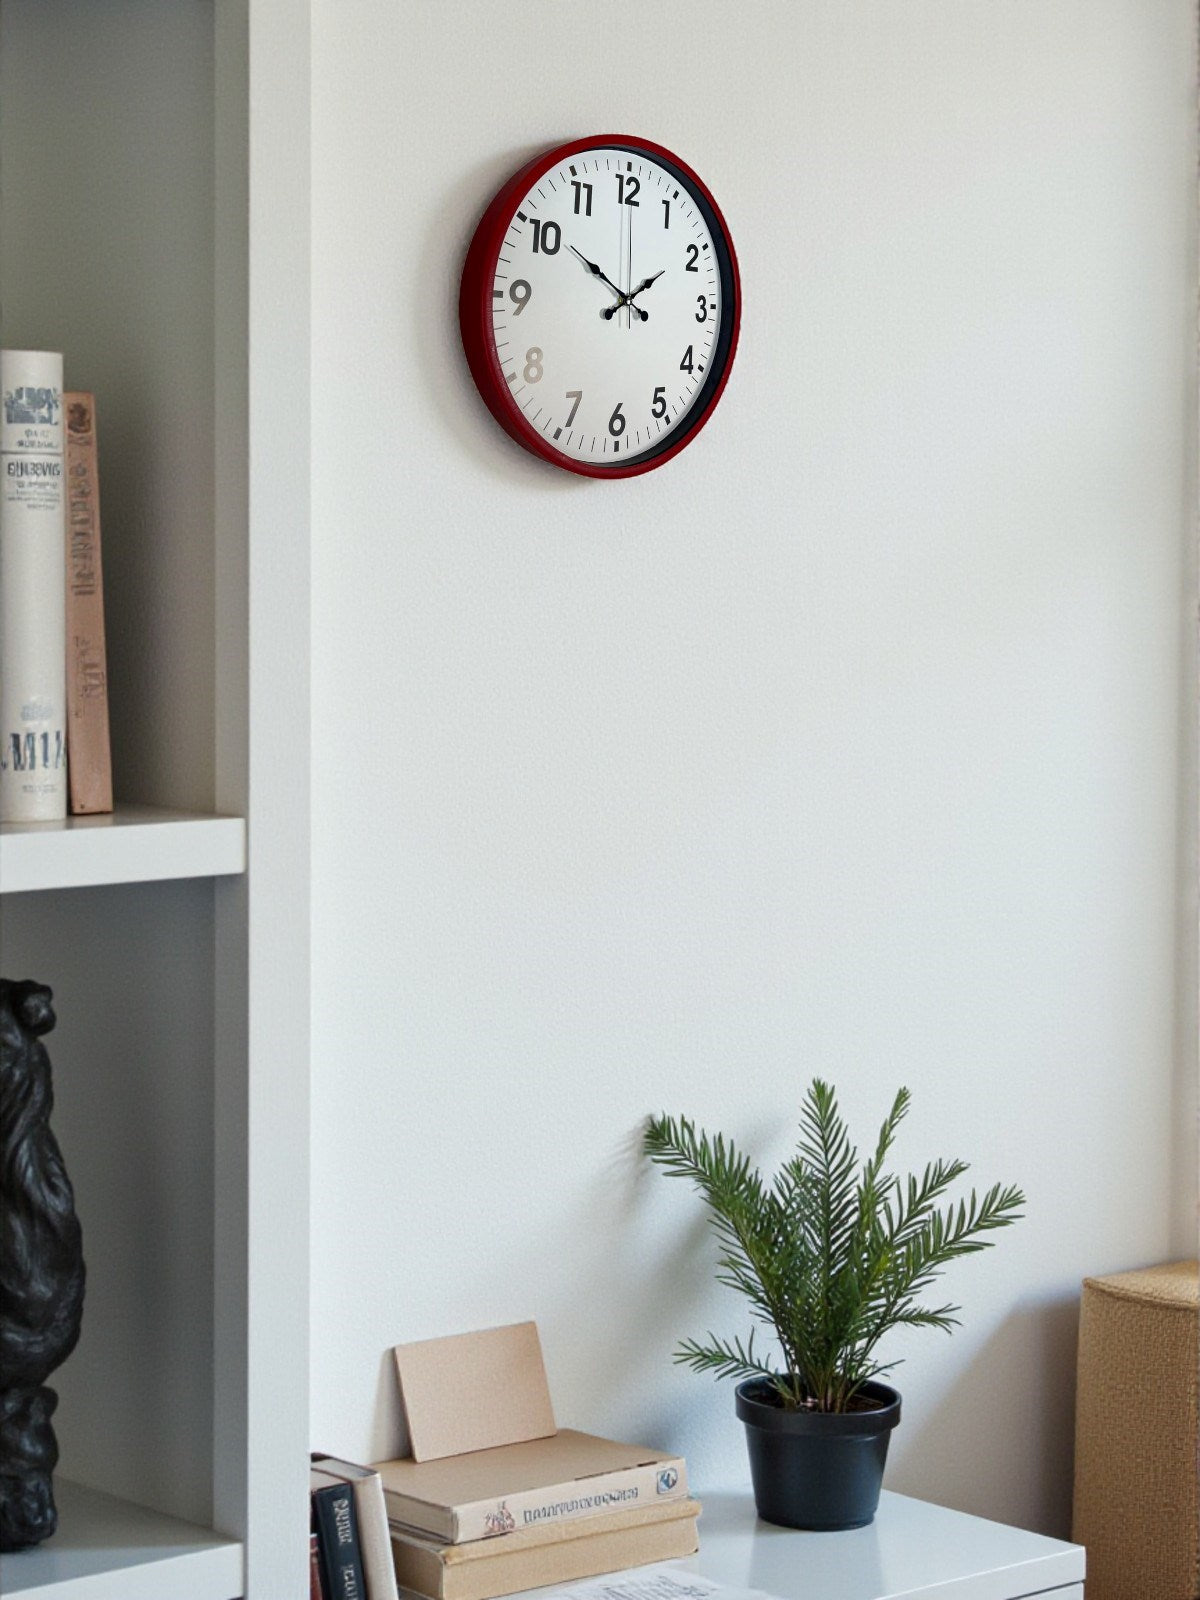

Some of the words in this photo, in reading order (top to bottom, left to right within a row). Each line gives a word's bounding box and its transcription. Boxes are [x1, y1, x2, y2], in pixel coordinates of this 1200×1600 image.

[570, 180, 593, 217] 11
[615, 173, 641, 207] 12
[661, 199, 670, 229] 1
[529, 218, 562, 256] 10
[685, 243, 699, 272] 2
[509, 279, 532, 316] 9
[694, 295, 707, 323] 3
[522, 346, 544, 384] 8
[679, 345, 694, 375] 4
[564, 390, 583, 428] 7
[607, 402, 626, 437] 6
[651, 386, 667, 419] 5
